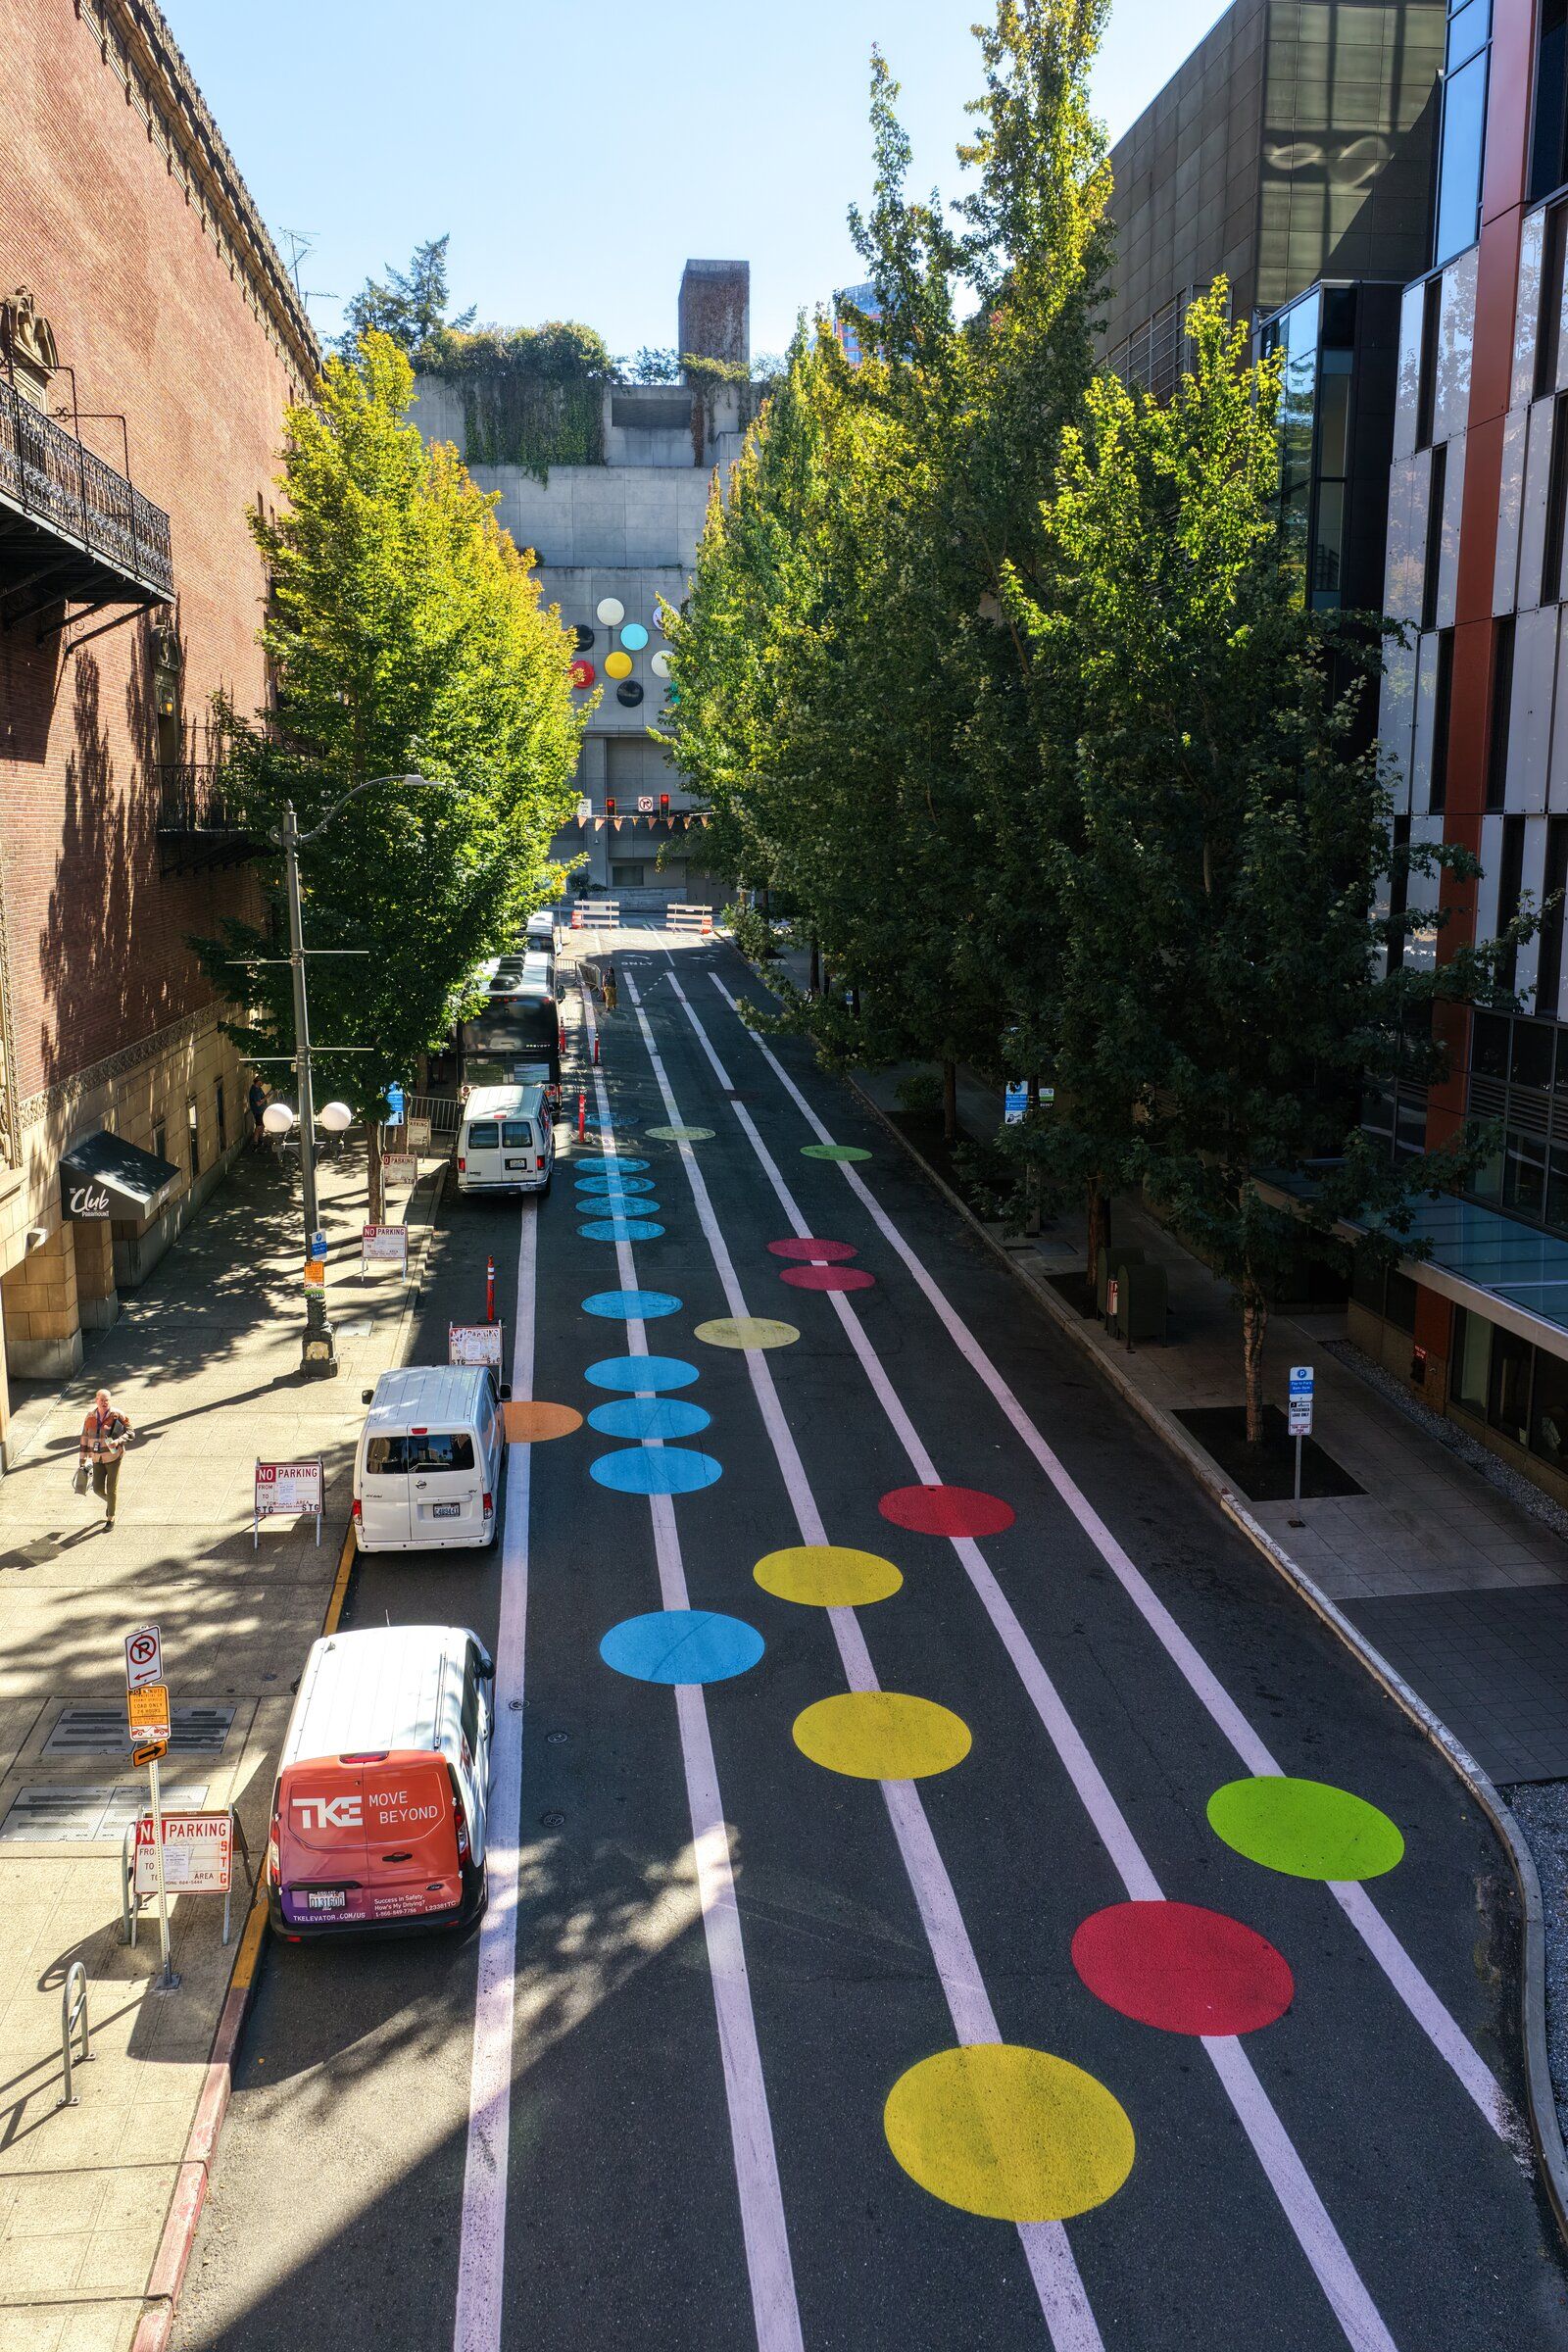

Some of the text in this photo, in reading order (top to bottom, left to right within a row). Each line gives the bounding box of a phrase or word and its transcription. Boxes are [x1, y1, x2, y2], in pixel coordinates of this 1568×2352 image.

[70, 1185, 110, 1213] Club
[365, 1228, 376, 1237] NO
[259, 1468, 318, 1481] NO PARKING
[255, 1505, 274, 1514] STG
[302, 1503, 319, 1512] STG
[292, 1790, 409, 1829] TKE MOVE
[379, 1805, 438, 1825] BEYOND
[140, 1823, 226, 1841] N PARKING
[293, 1912, 367, 1922] TKELEVATOR.COM/US
